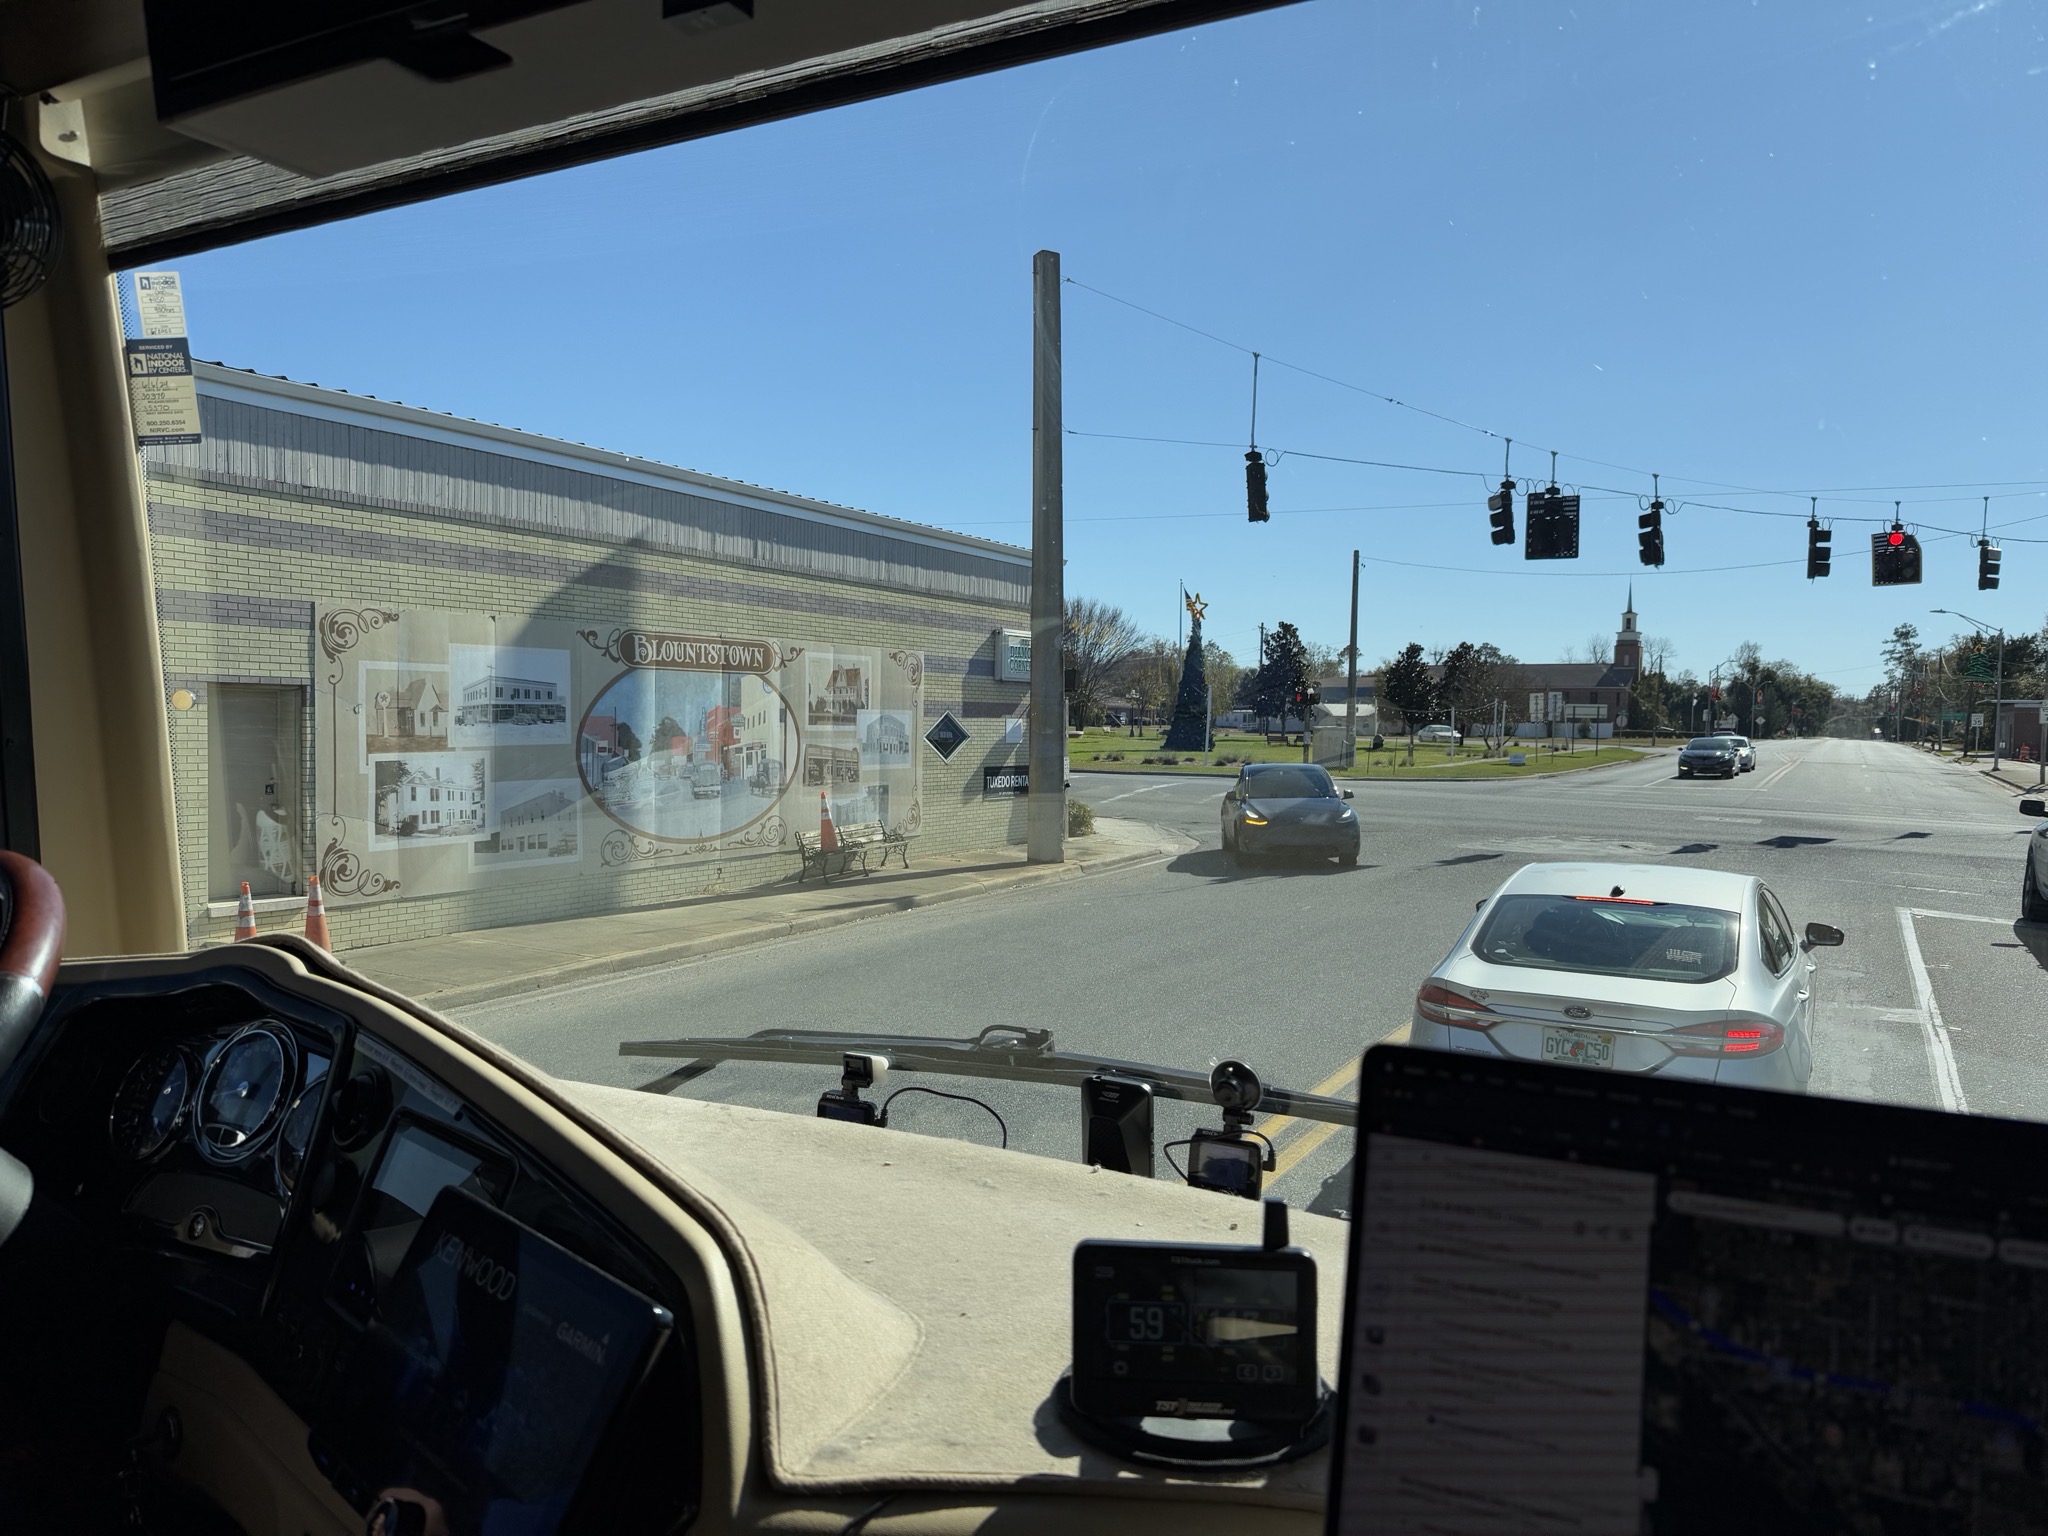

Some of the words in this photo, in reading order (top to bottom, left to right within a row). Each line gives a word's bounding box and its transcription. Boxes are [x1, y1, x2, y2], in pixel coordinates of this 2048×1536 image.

[147, 352, 184, 360] NATIONAL
[158, 366, 187, 374] CENTERS
[633, 634, 764, 669] BLOUNTSTOWN
[986, 775, 1010, 789] TUXEDO
[1546, 1037, 1570, 1055] GYC
[1585, 1042, 1610, 1061] C50
[432, 1229, 517, 1302] KENWOOD
[1129, 1306, 1165, 1340] 59
[556, 1321, 608, 1367] GARMIN
[1155, 1400, 1179, 1411] TST
